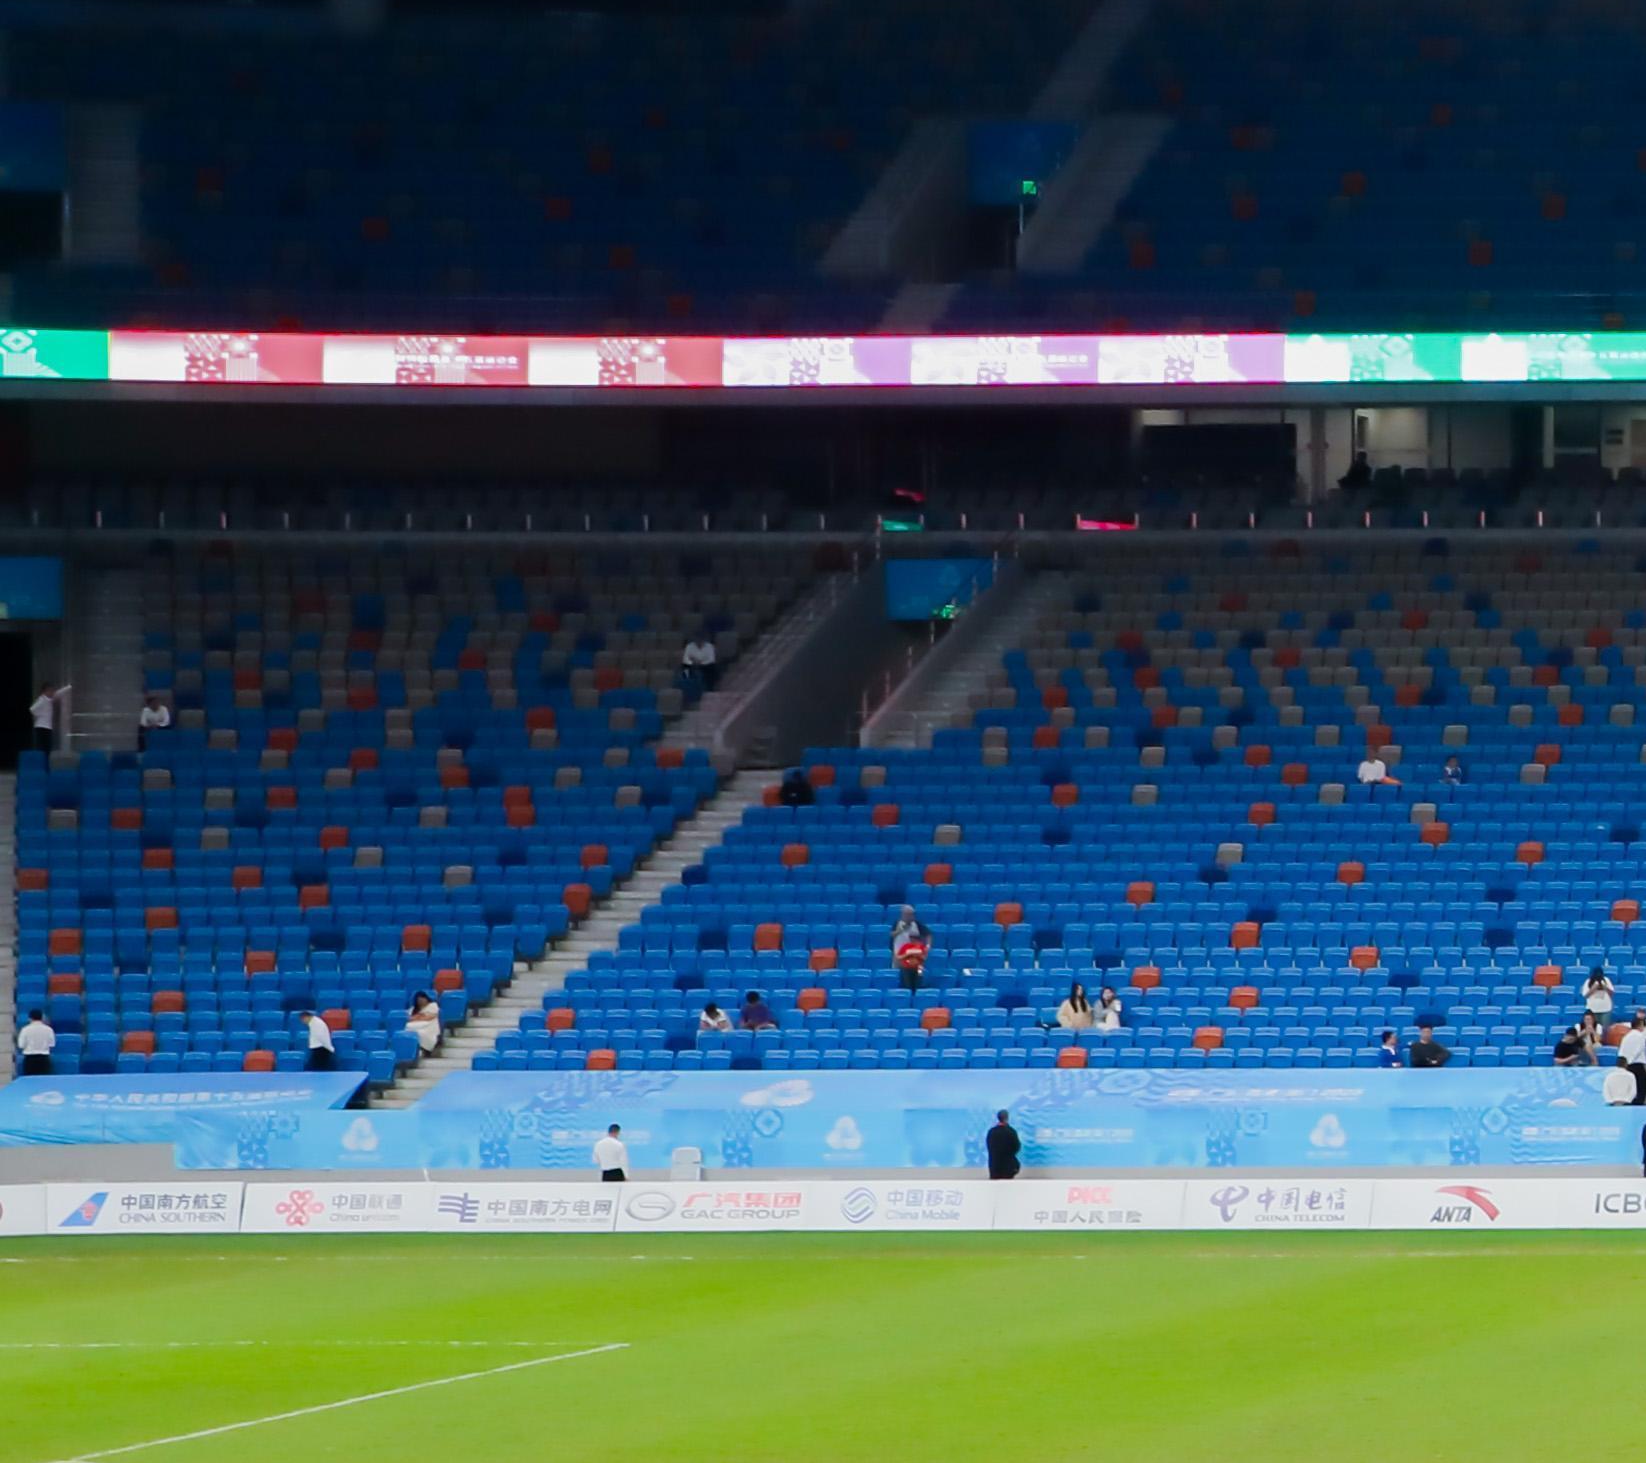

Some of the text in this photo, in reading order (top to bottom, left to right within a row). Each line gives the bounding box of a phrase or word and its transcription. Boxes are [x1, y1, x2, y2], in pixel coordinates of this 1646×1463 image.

[121, 1193, 227, 1210] 中国南方航空
[332, 1194, 402, 1210] 中国联通
[682, 1192, 802, 1209] 广汽集团
[886, 1189, 964, 1207] 中国移动
[1066, 1186, 1113, 1204] PICC
[1257, 1187, 1346, 1212] 中国电信
[487, 1199, 613, 1218] 中国南方电网
[680, 1208, 800, 1219] GAC GROUP
[922, 1209, 960, 1220] Mobile
[1430, 1206, 1472, 1222] ANTA
[118, 1211, 226, 1224] CHINA SOUTHERN
[1034, 1210, 1142, 1224] 中国人民保险
[1255, 1212, 1345, 1222] CHINA TELECOM
